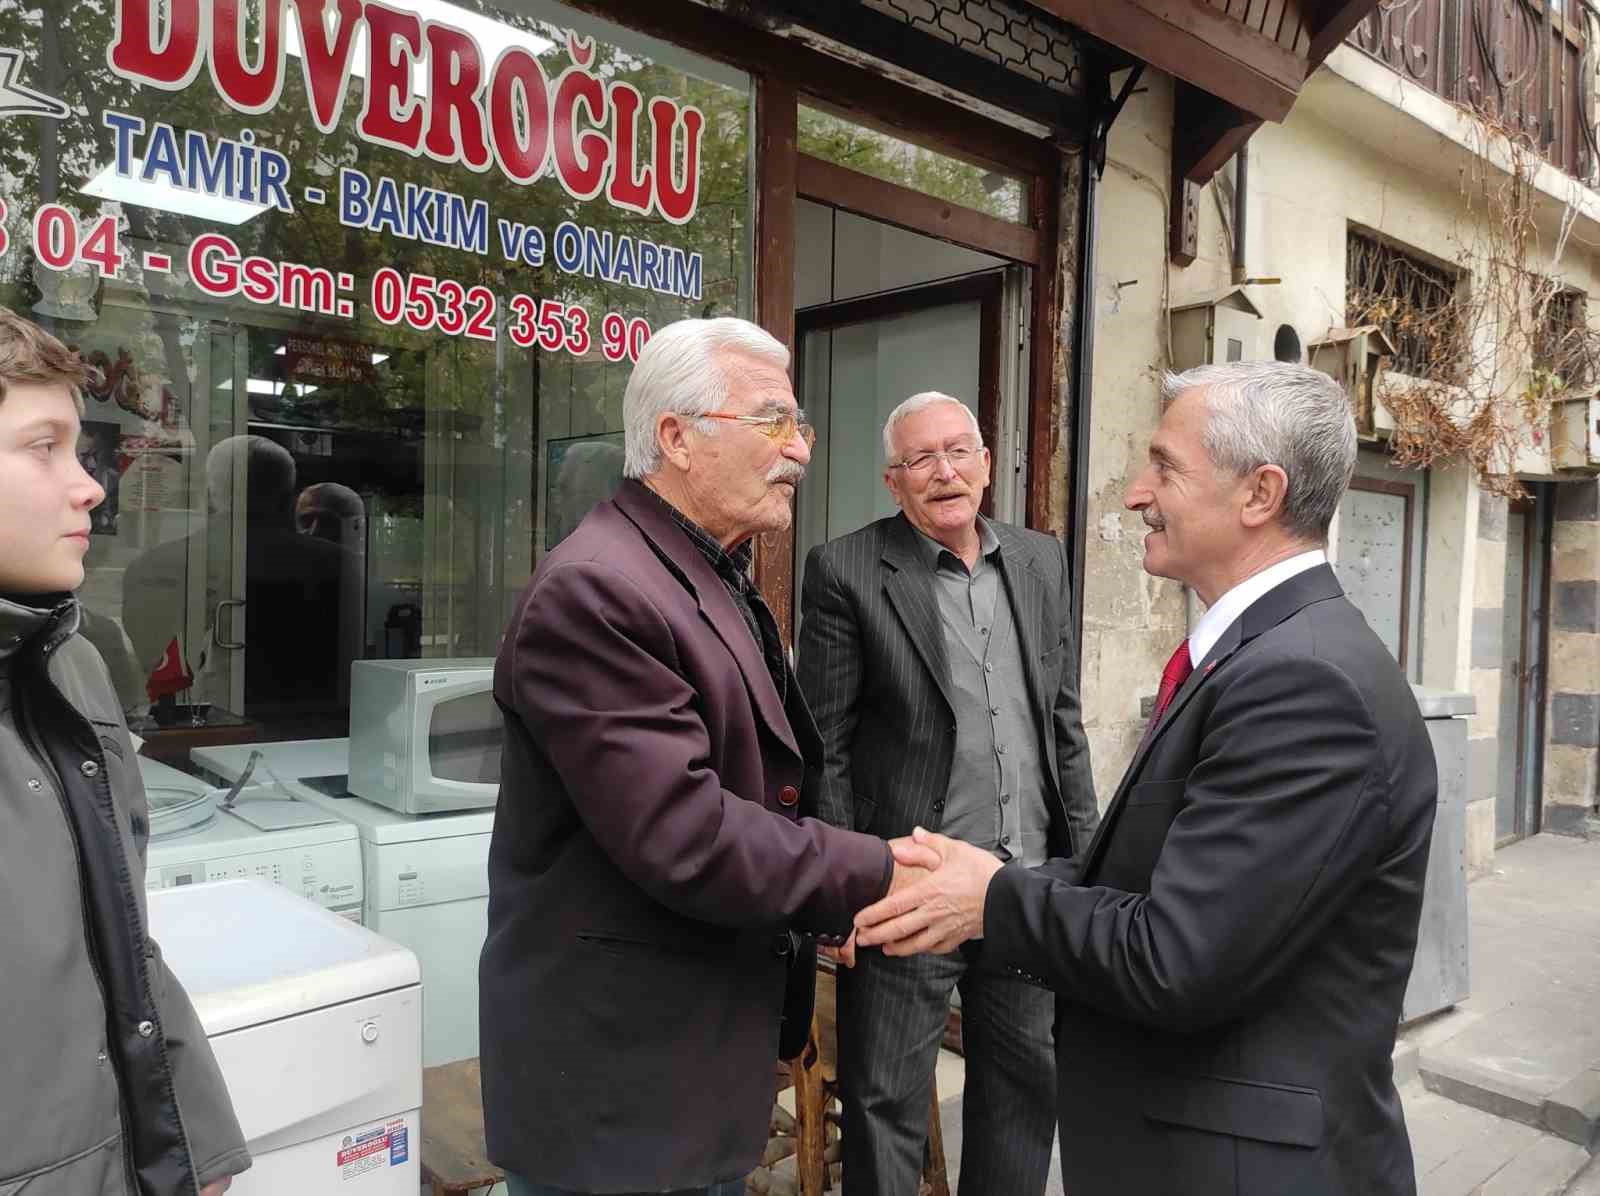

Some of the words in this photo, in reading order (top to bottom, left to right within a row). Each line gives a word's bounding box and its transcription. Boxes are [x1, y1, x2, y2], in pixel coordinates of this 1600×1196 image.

[33, 203, 123, 278] 04
[188, 233, 354, 318] Gsm:
[372, 267, 497, 341] 0532
[509, 294, 591, 356] 353
[103, 110, 294, 212] TAMİR
[340, 167, 488, 254] BAKIM
[498, 219, 545, 267] ve
[554, 222, 702, 300] ONARIM
